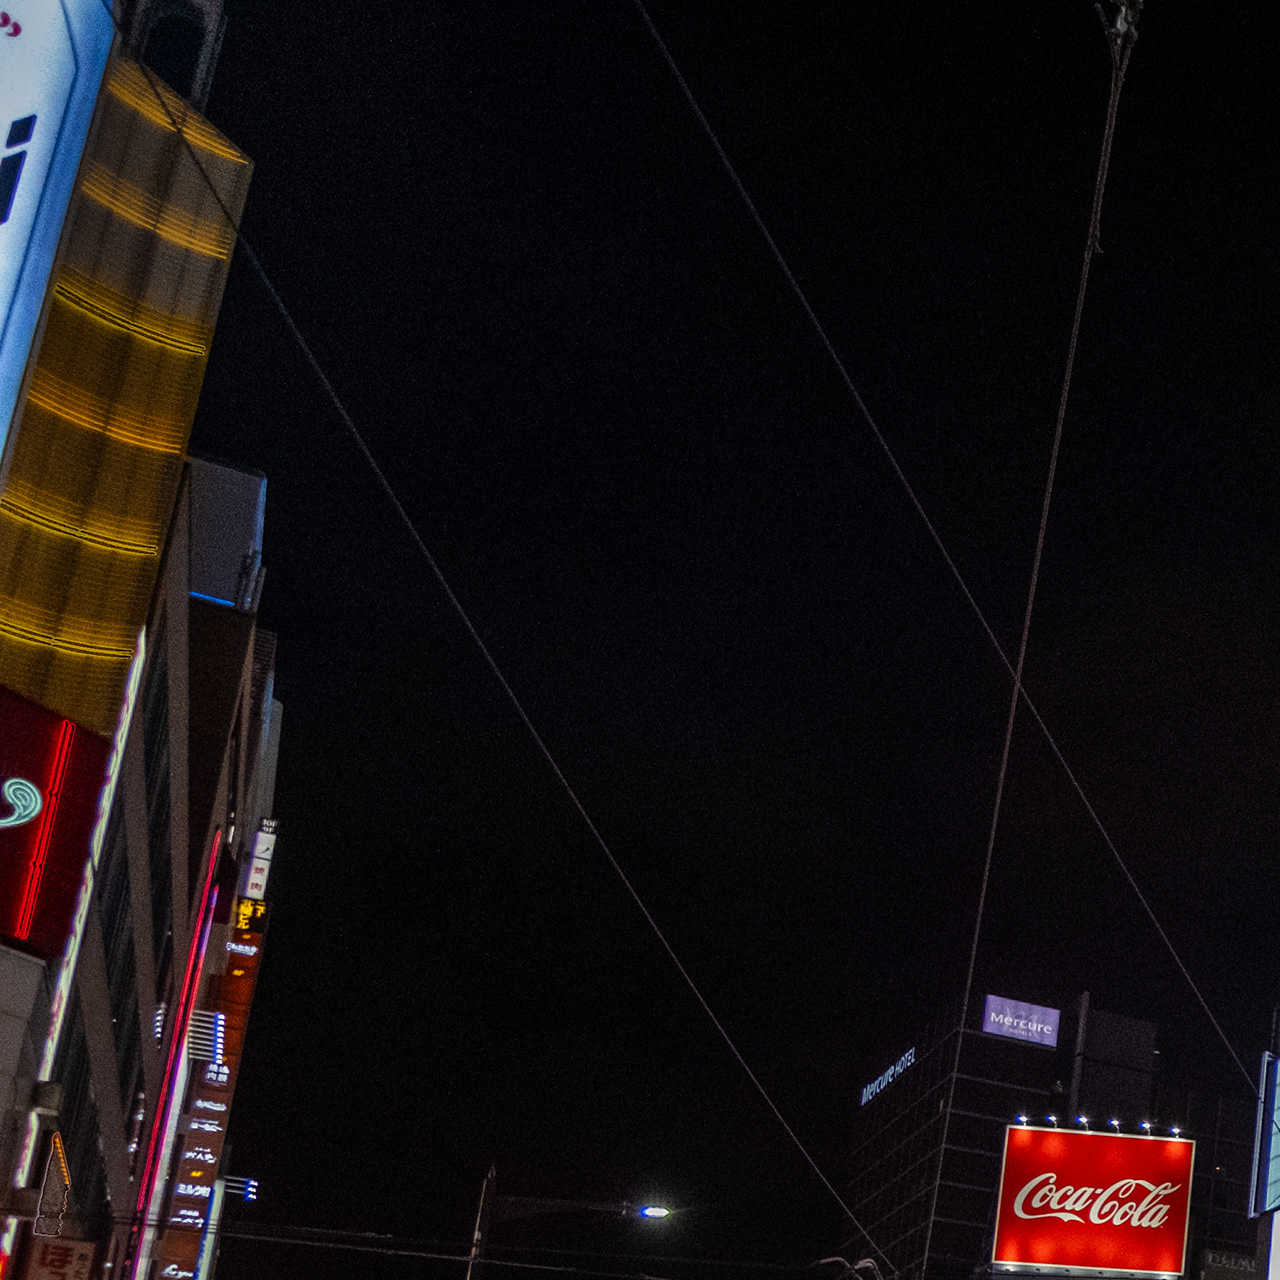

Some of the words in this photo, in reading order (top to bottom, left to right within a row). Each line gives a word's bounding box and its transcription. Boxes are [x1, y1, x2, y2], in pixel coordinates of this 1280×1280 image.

[990, 1012, 1053, 1034] Mercure
[862, 1065, 894, 1106] Mercure
[894, 1047, 915, 1078] HOTEL
[1013, 1172, 1182, 1229] Coca-Cola
